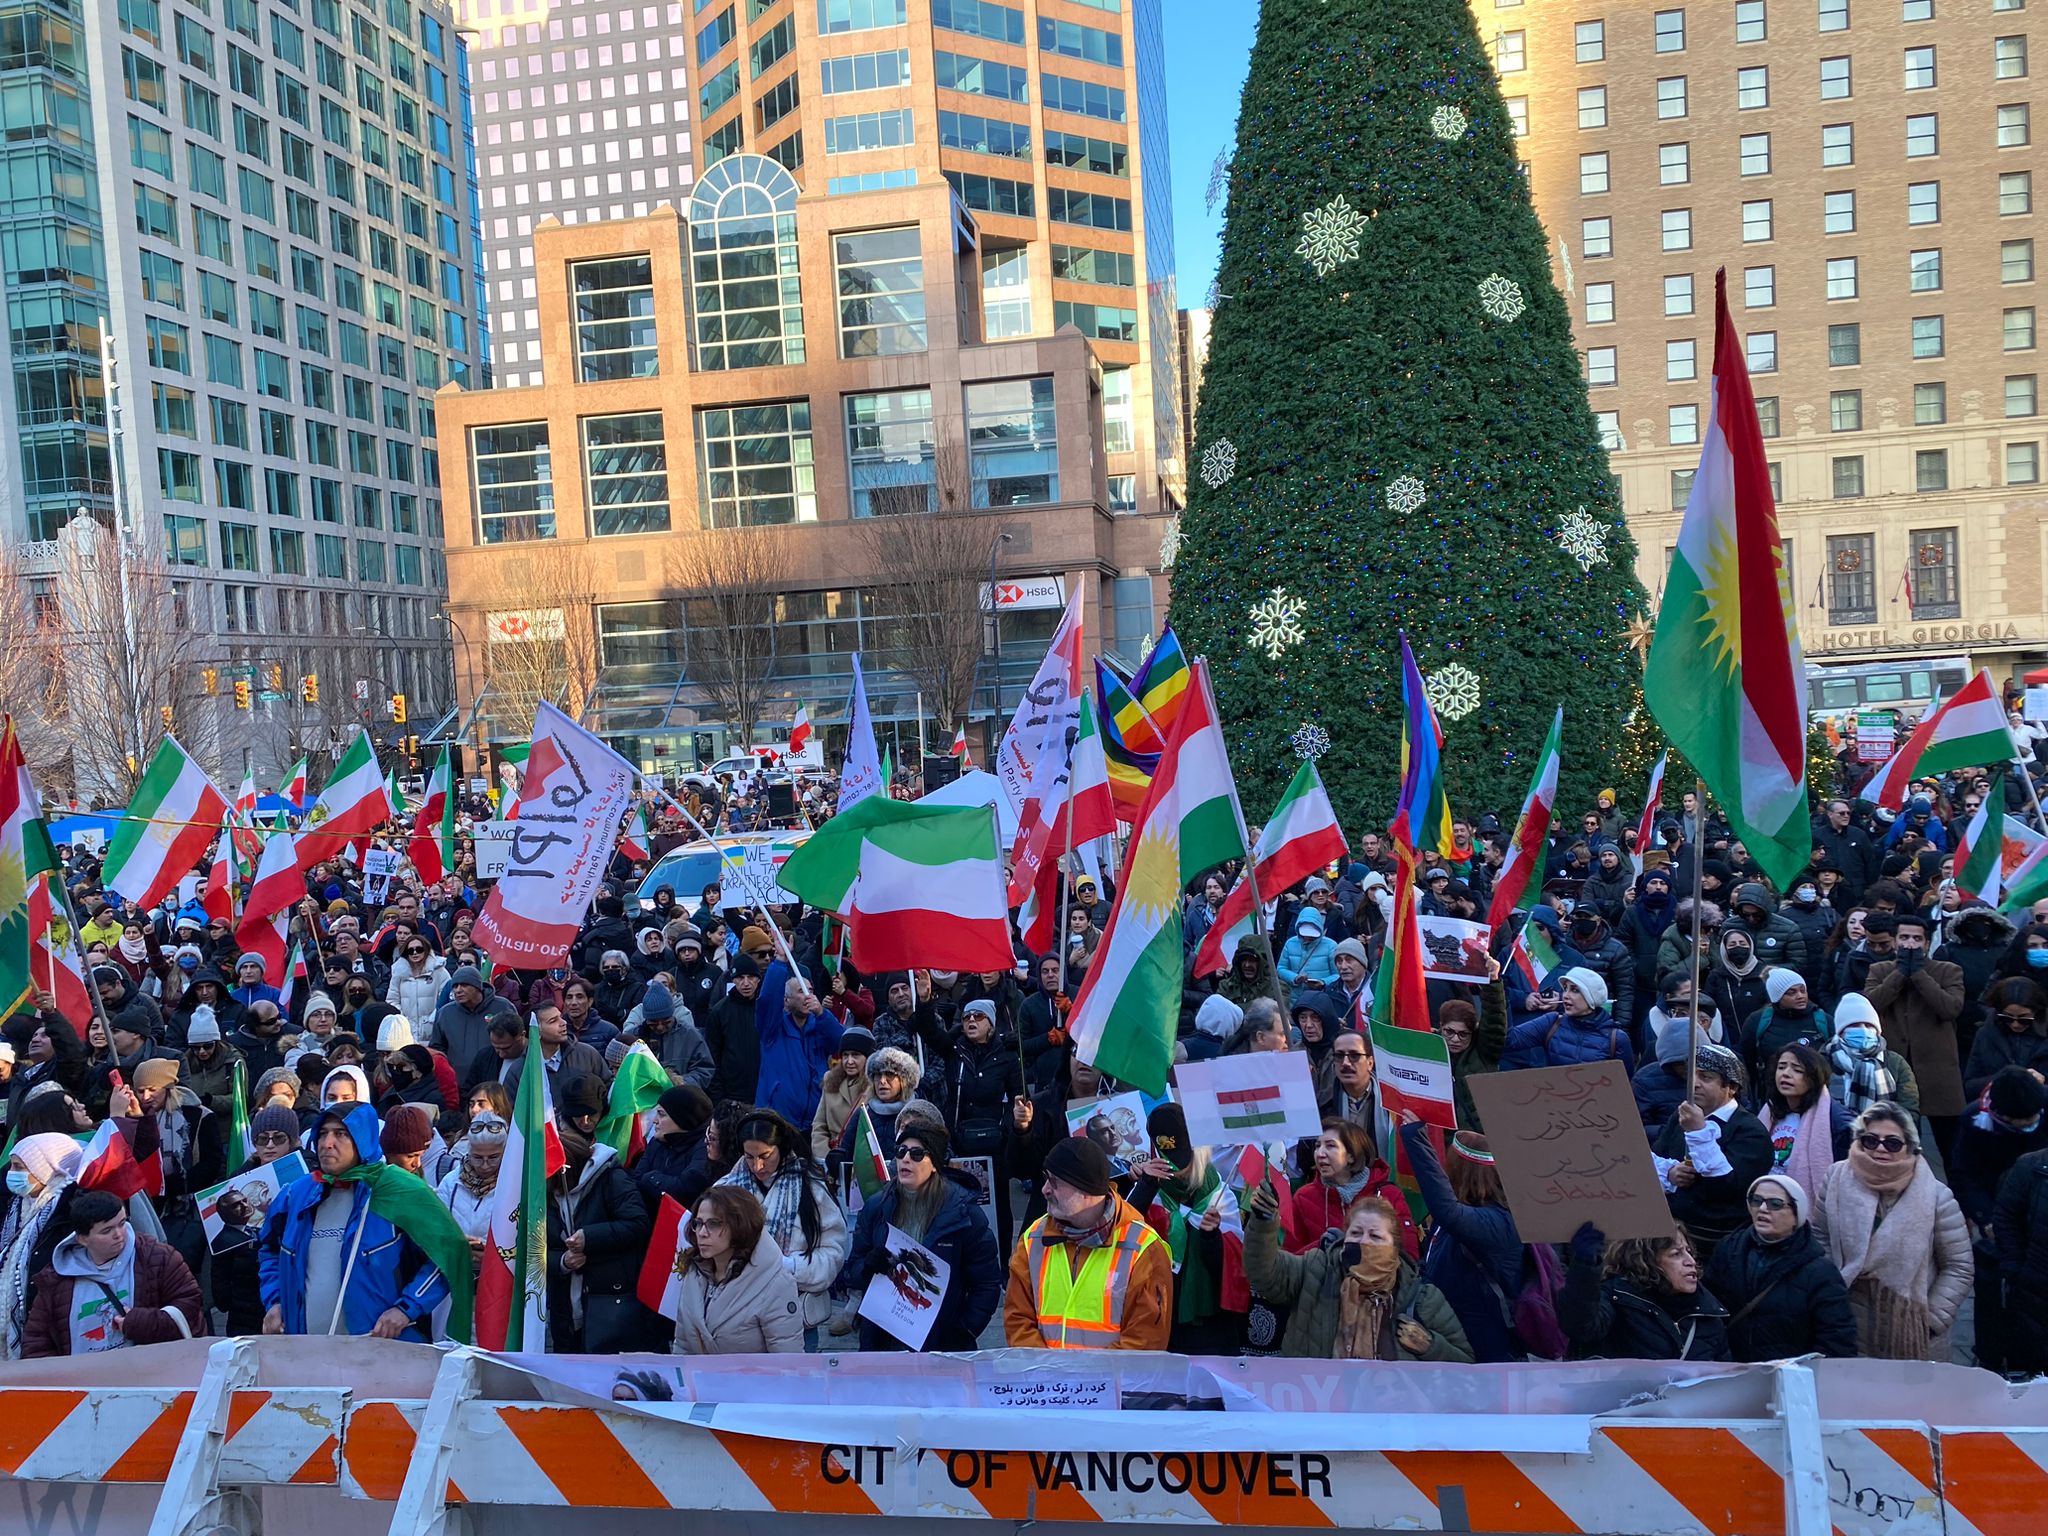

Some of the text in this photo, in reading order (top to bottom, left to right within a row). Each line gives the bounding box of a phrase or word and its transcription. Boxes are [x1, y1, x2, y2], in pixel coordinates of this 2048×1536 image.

[1026, 586, 1055, 598] HSBC
[1822, 622, 2019, 649] HOTEL GEORGIA
[781, 750, 808, 760] HSBC
[744, 844, 770, 862] WE
[744, 886, 788, 906] BACK
[946, 1450, 1010, 1489] OF
[1029, 1450, 1333, 1498] VANCOUVER
